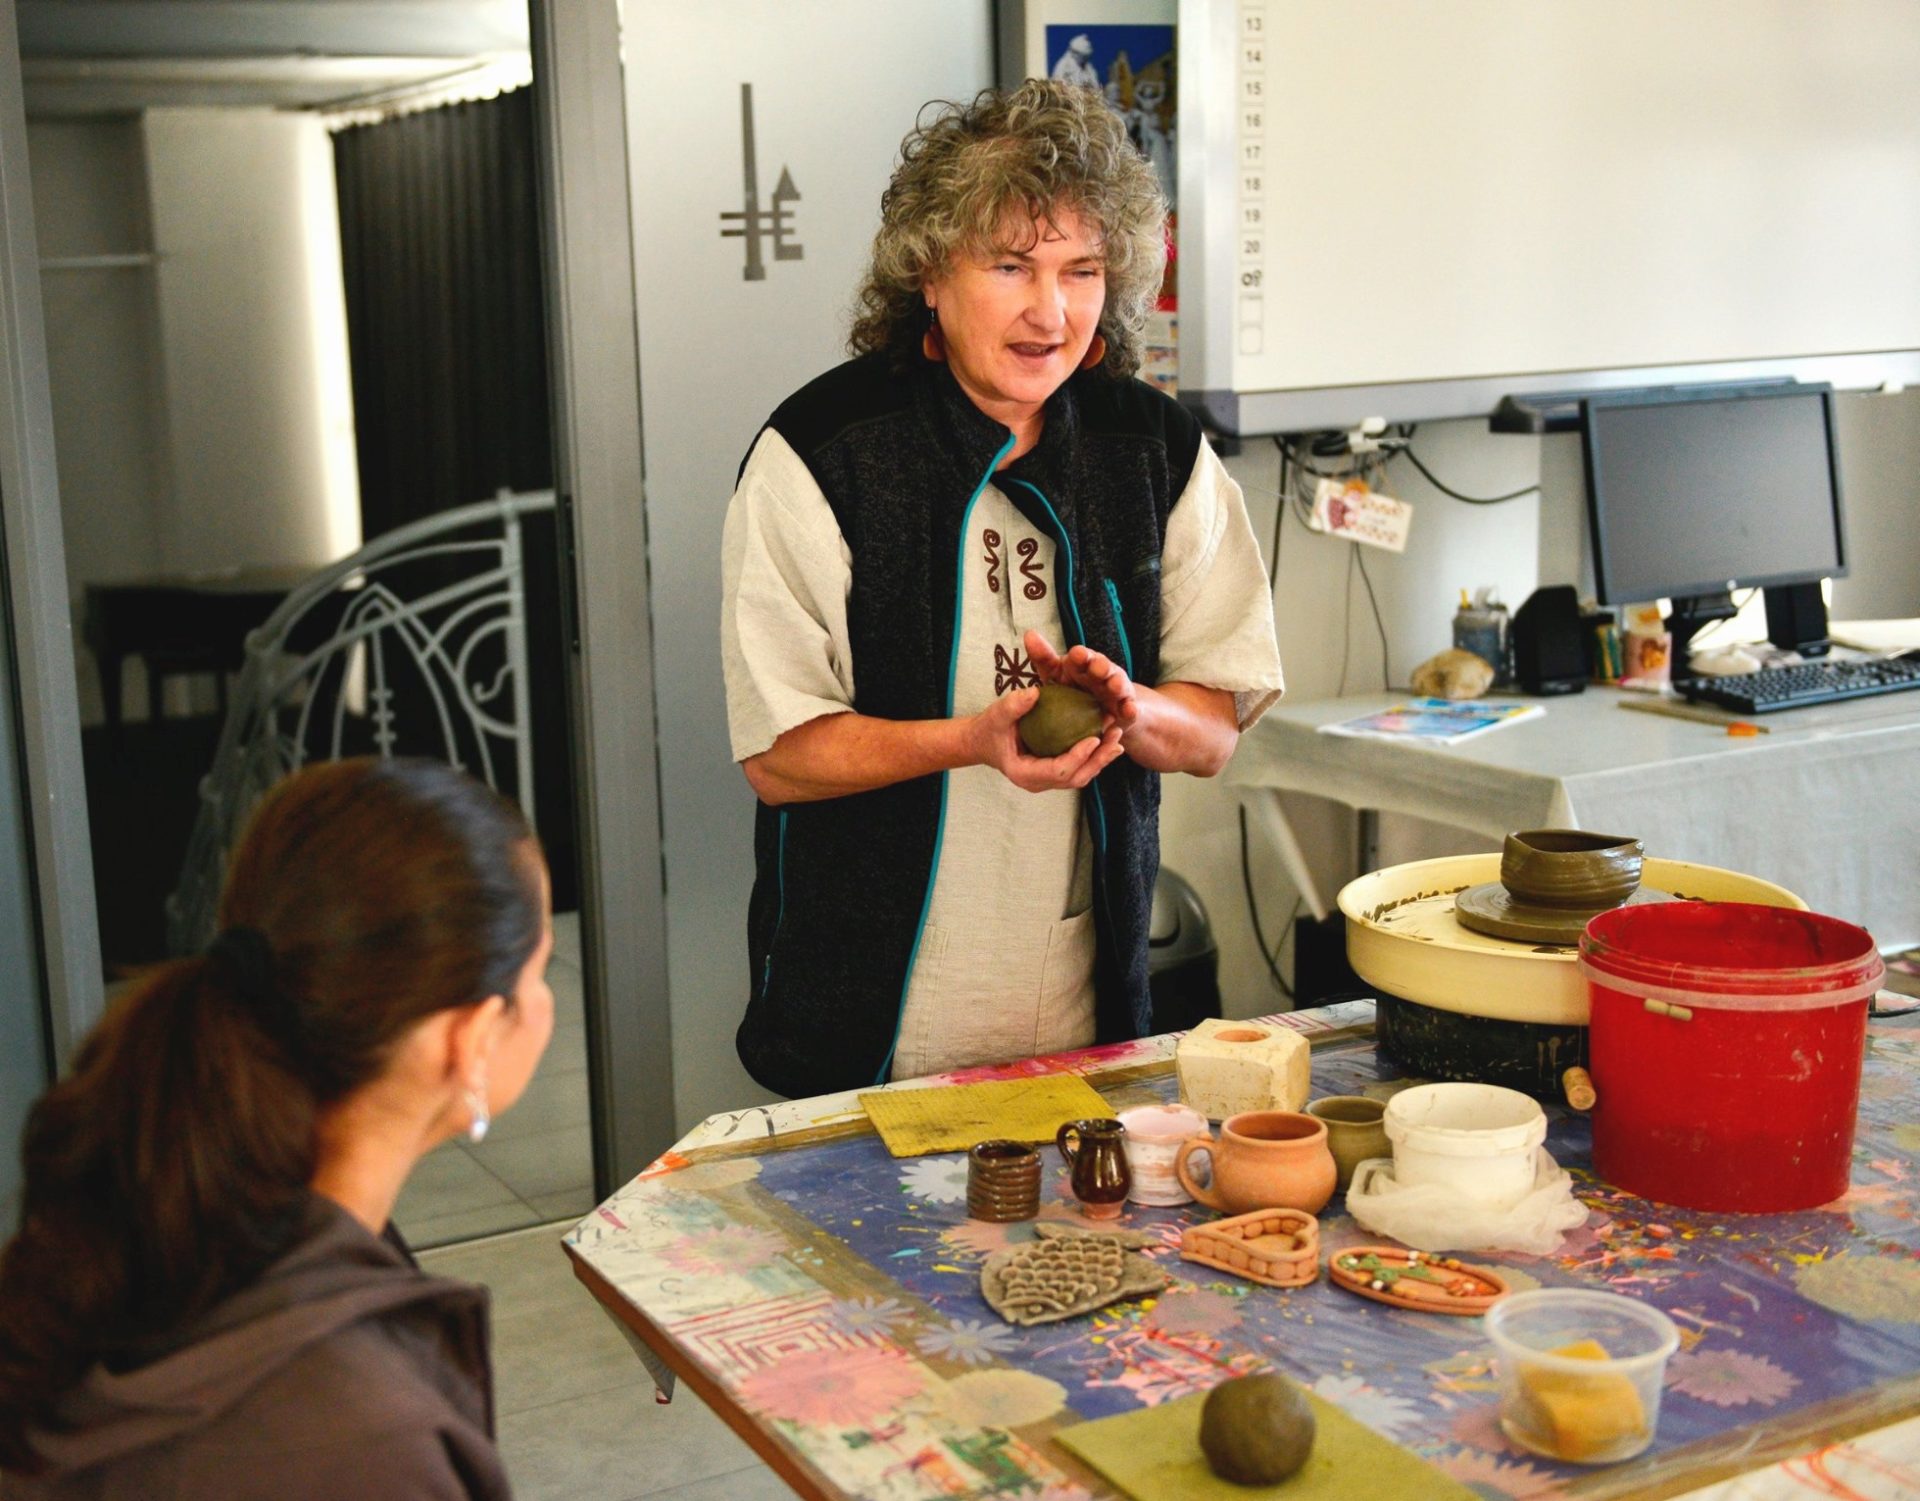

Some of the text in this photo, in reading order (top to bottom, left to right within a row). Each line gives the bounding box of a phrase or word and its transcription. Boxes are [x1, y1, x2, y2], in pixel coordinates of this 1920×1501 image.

[1246, 17, 1262, 31] 13
[1246, 50, 1262, 63] 14
[1246, 82, 1262, 95] 15
